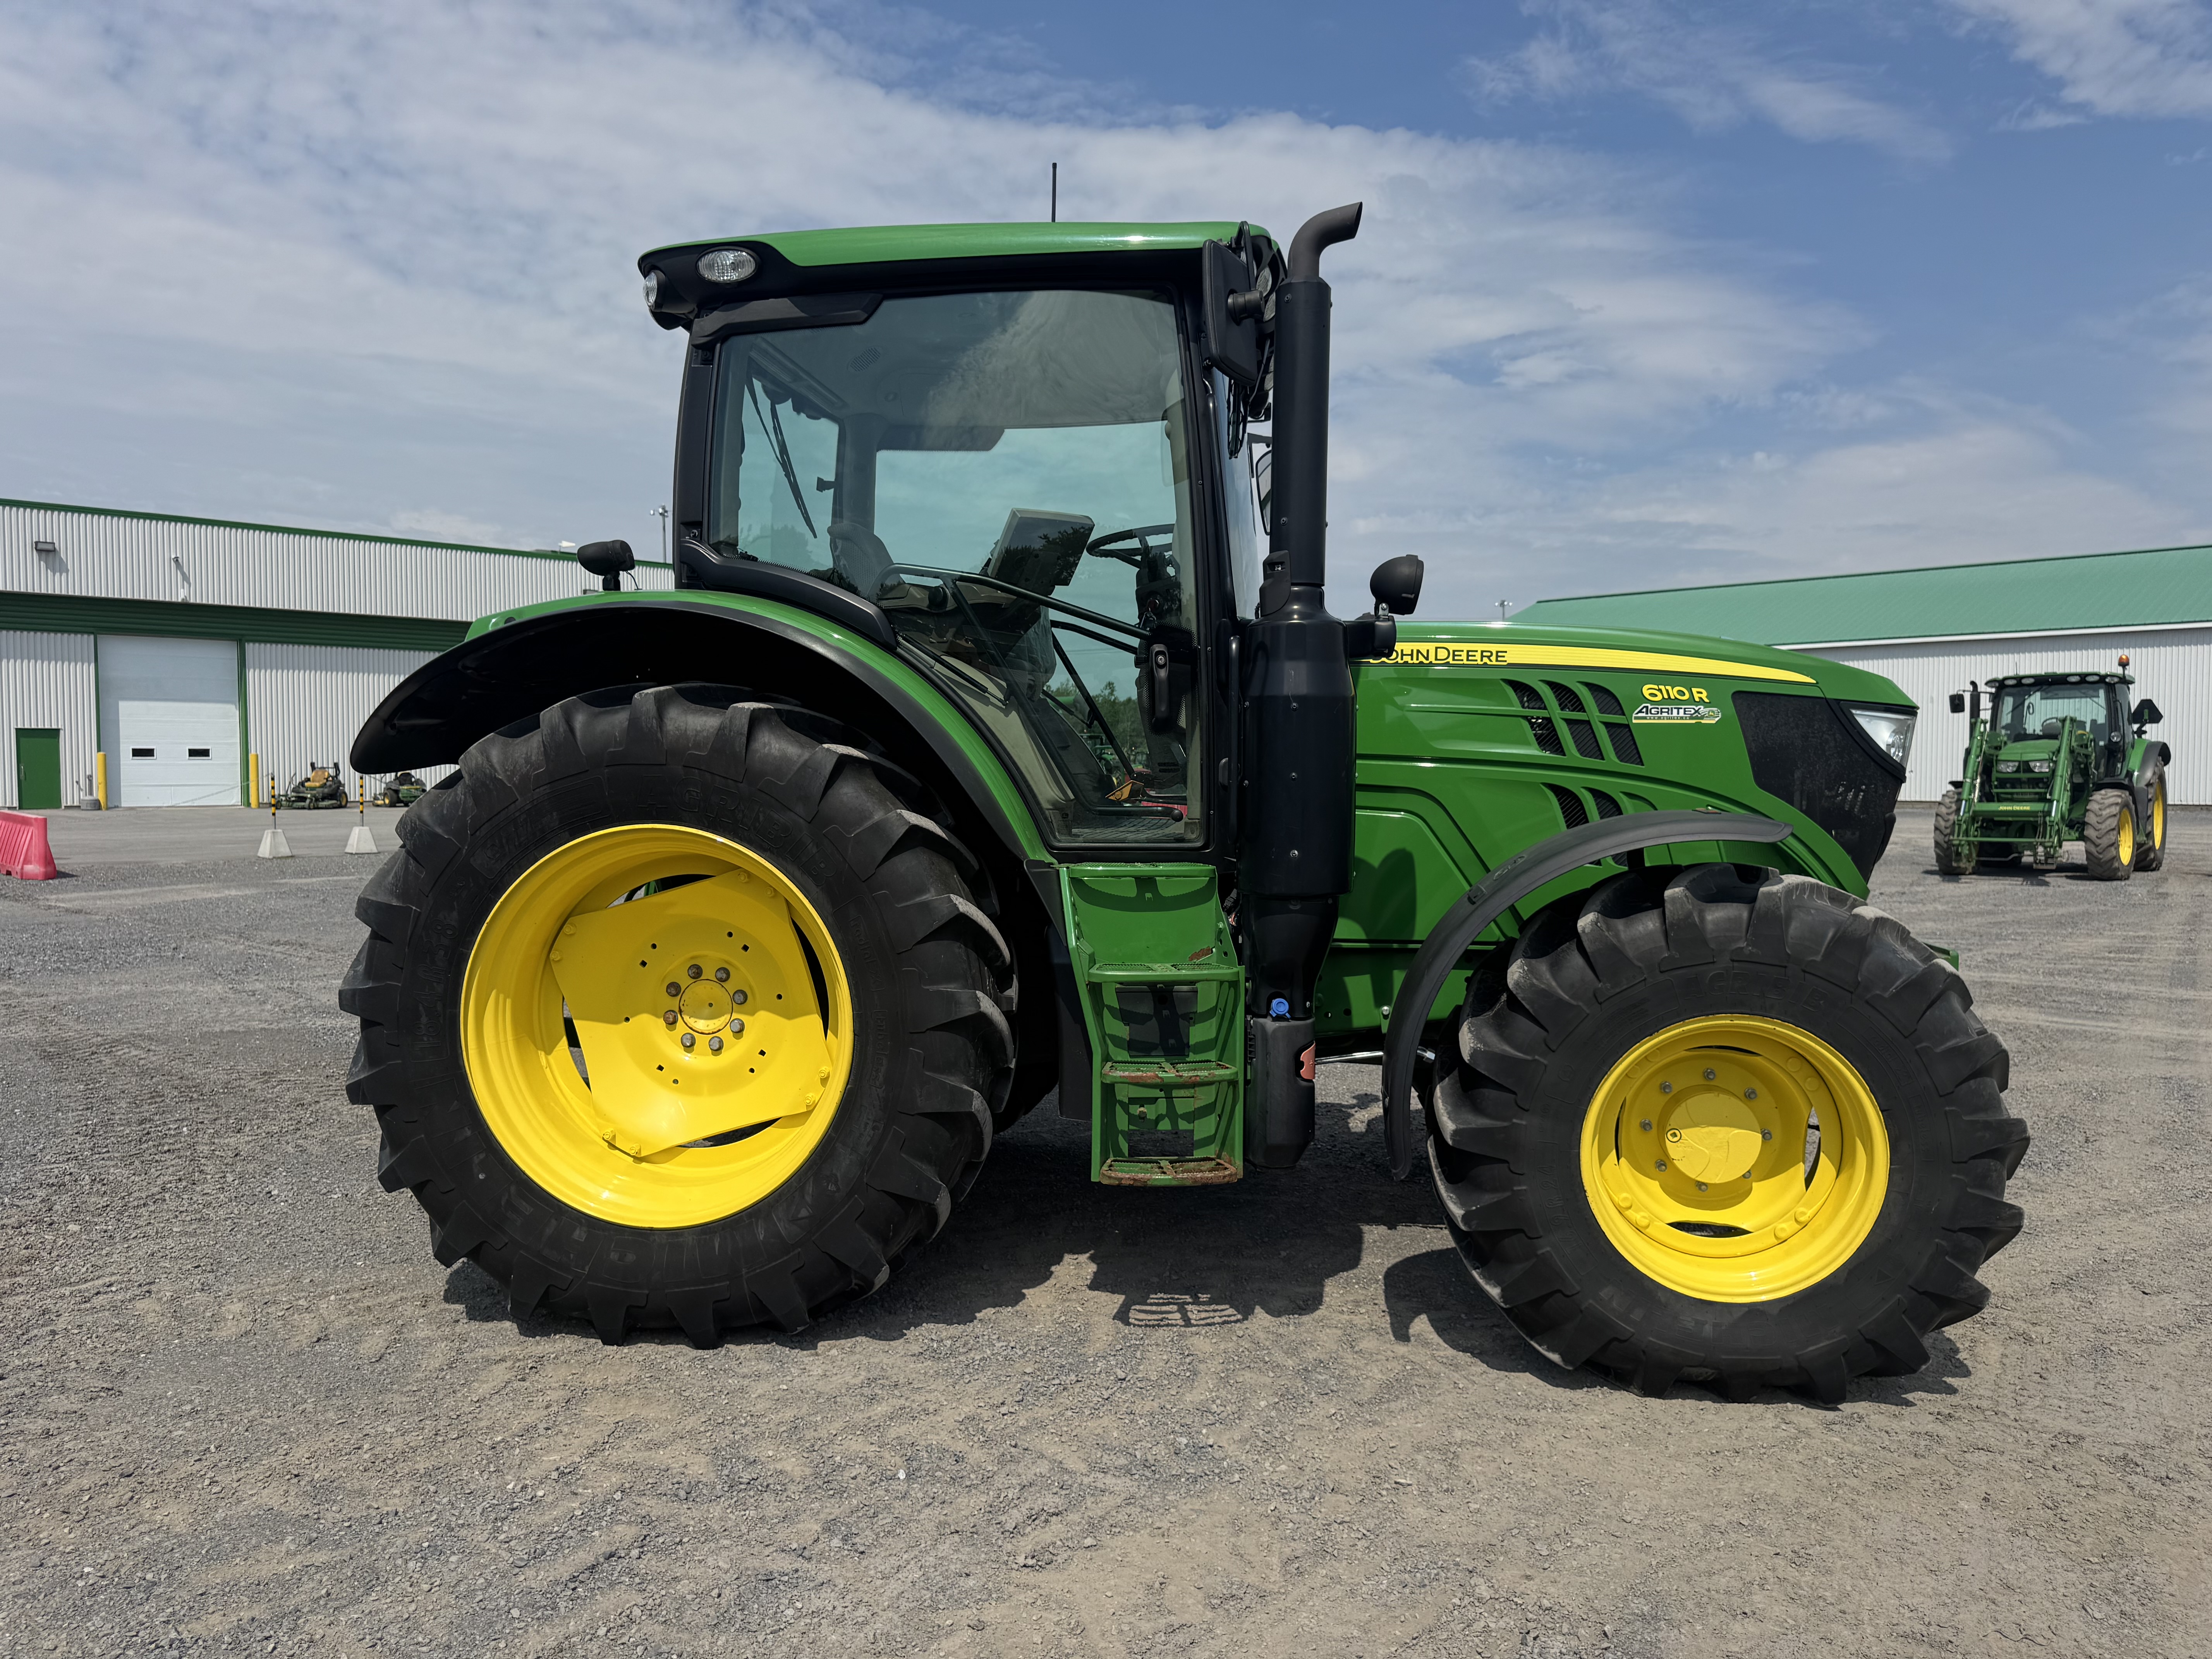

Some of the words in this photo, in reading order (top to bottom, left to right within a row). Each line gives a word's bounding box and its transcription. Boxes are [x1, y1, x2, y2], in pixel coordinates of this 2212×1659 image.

[1372, 649, 1429, 661] OHN
[1435, 647, 1508, 662] DEERE
[1642, 684, 1690, 701] 6110
[1691, 687, 1710, 702] R
[1635, 705, 1702, 716] AGRITEX
